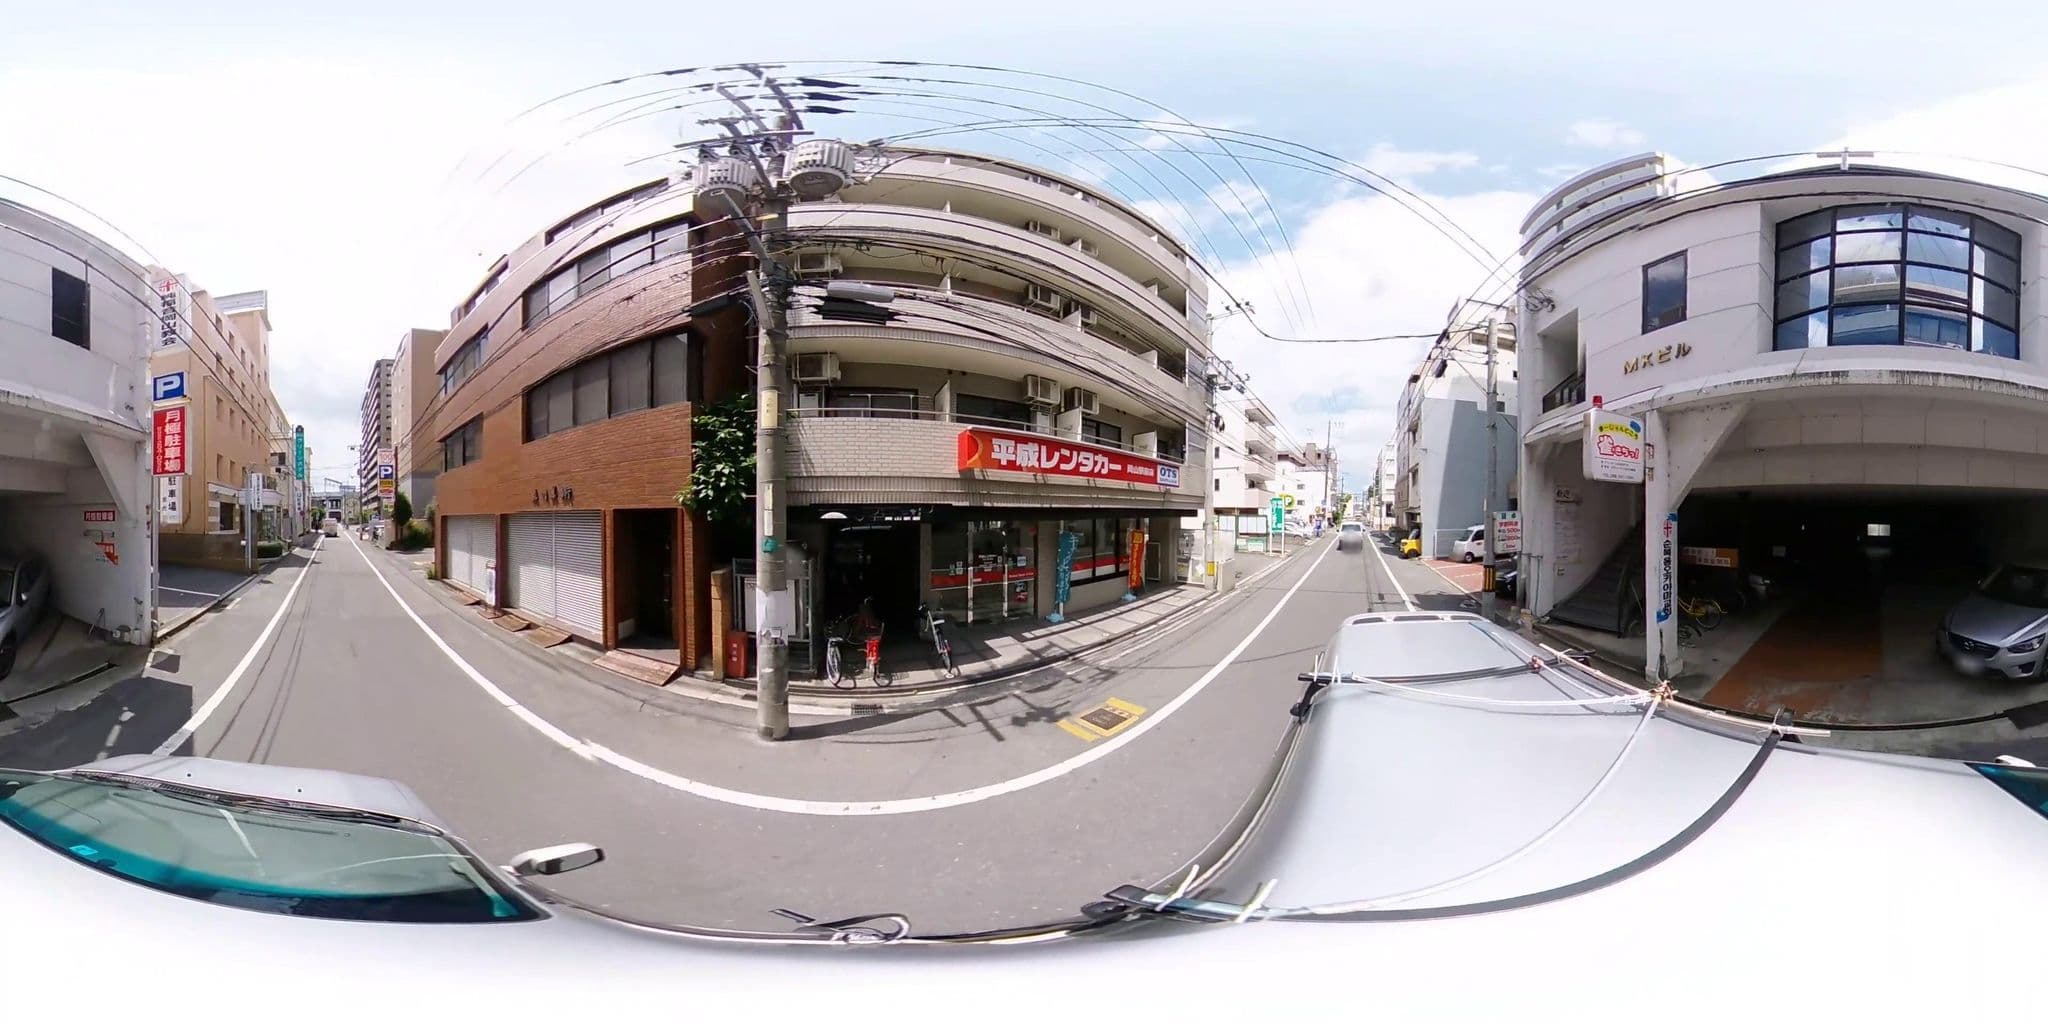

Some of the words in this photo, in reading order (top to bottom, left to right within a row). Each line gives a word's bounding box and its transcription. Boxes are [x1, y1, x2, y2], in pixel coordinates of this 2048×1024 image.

[1624, 343, 1692, 375] MKビル
[156, 374, 181, 398] P
[164, 409, 181, 472] 月極駐車場
[991, 438, 1122, 475] 平成レンタカー
[380, 466, 393, 478] P
[1160, 467, 1177, 479] OTS
[1284, 496, 1293, 506] P
